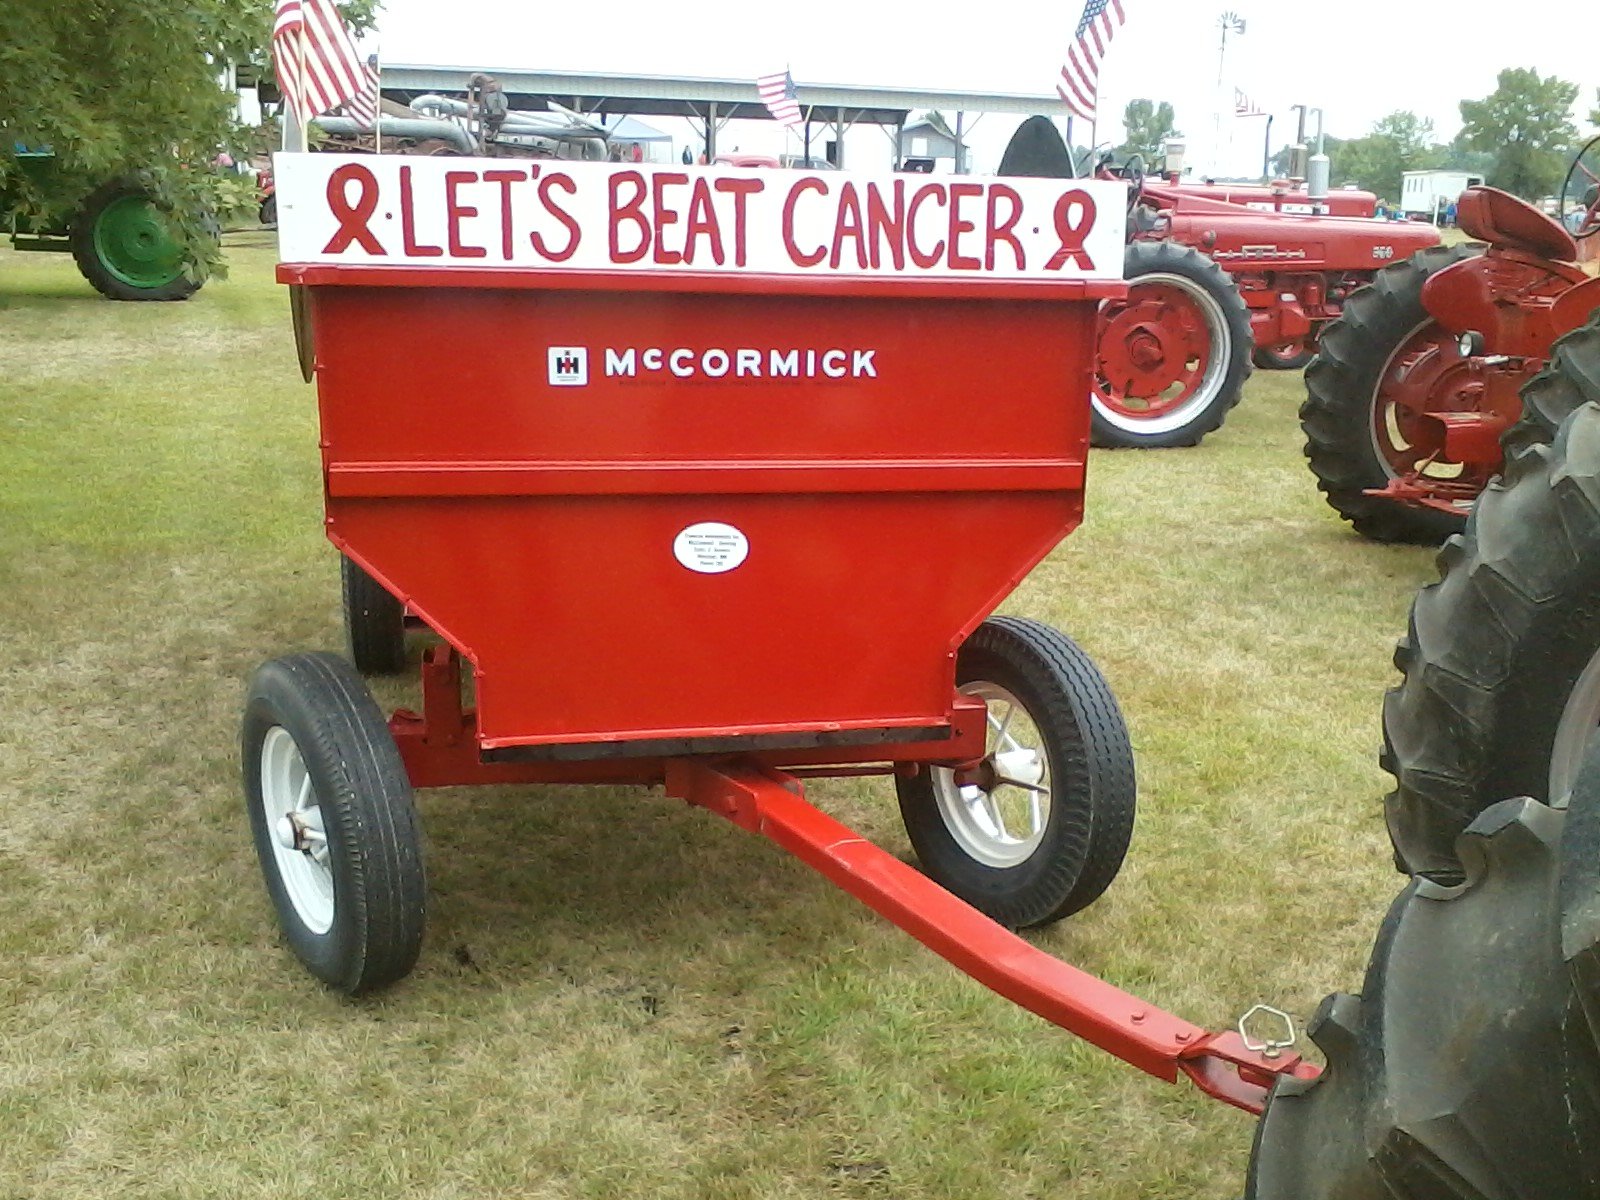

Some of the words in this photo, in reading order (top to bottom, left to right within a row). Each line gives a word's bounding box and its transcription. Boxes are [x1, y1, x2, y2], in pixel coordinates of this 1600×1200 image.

[399, 164, 582, 263] LET'S
[608, 170, 765, 267] BEAT
[782, 176, 1026, 271] CANCER
